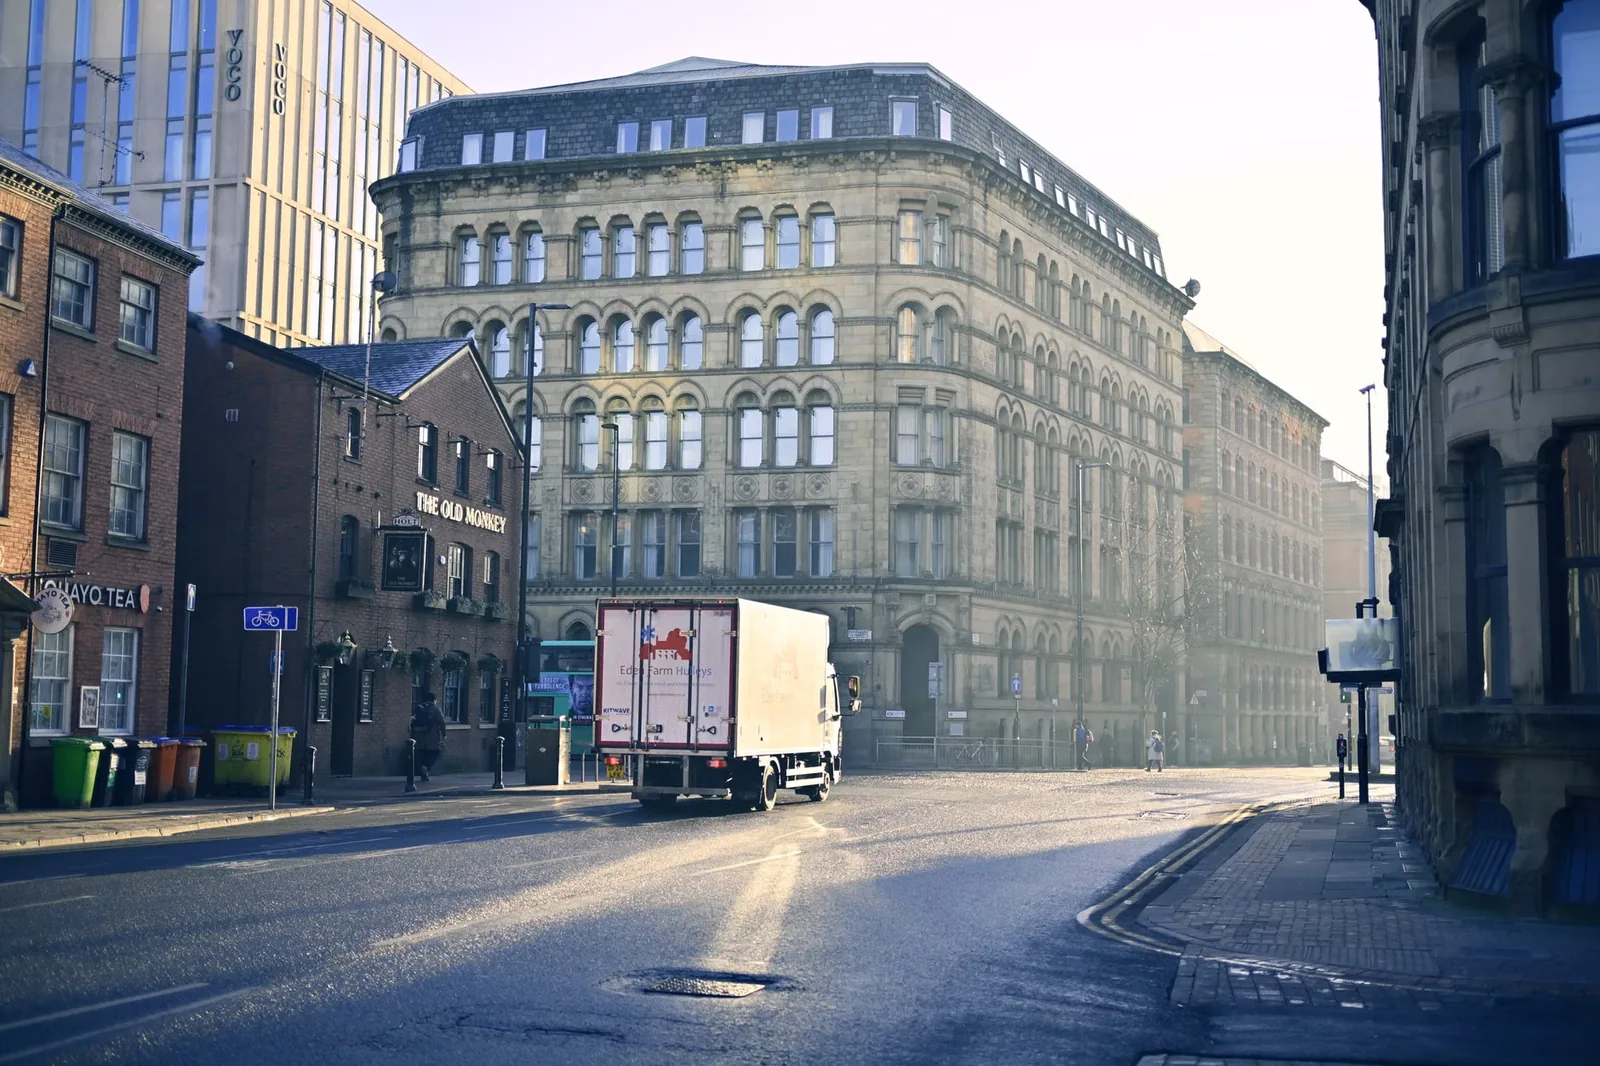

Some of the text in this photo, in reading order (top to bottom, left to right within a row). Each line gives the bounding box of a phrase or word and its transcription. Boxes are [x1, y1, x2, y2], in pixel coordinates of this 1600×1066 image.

[416, 491, 507, 534] THE OLD MONKEY
[59, 593, 70, 610] TEA
[106, 587, 136, 609] TEA
[648, 665, 673, 675] Farm
